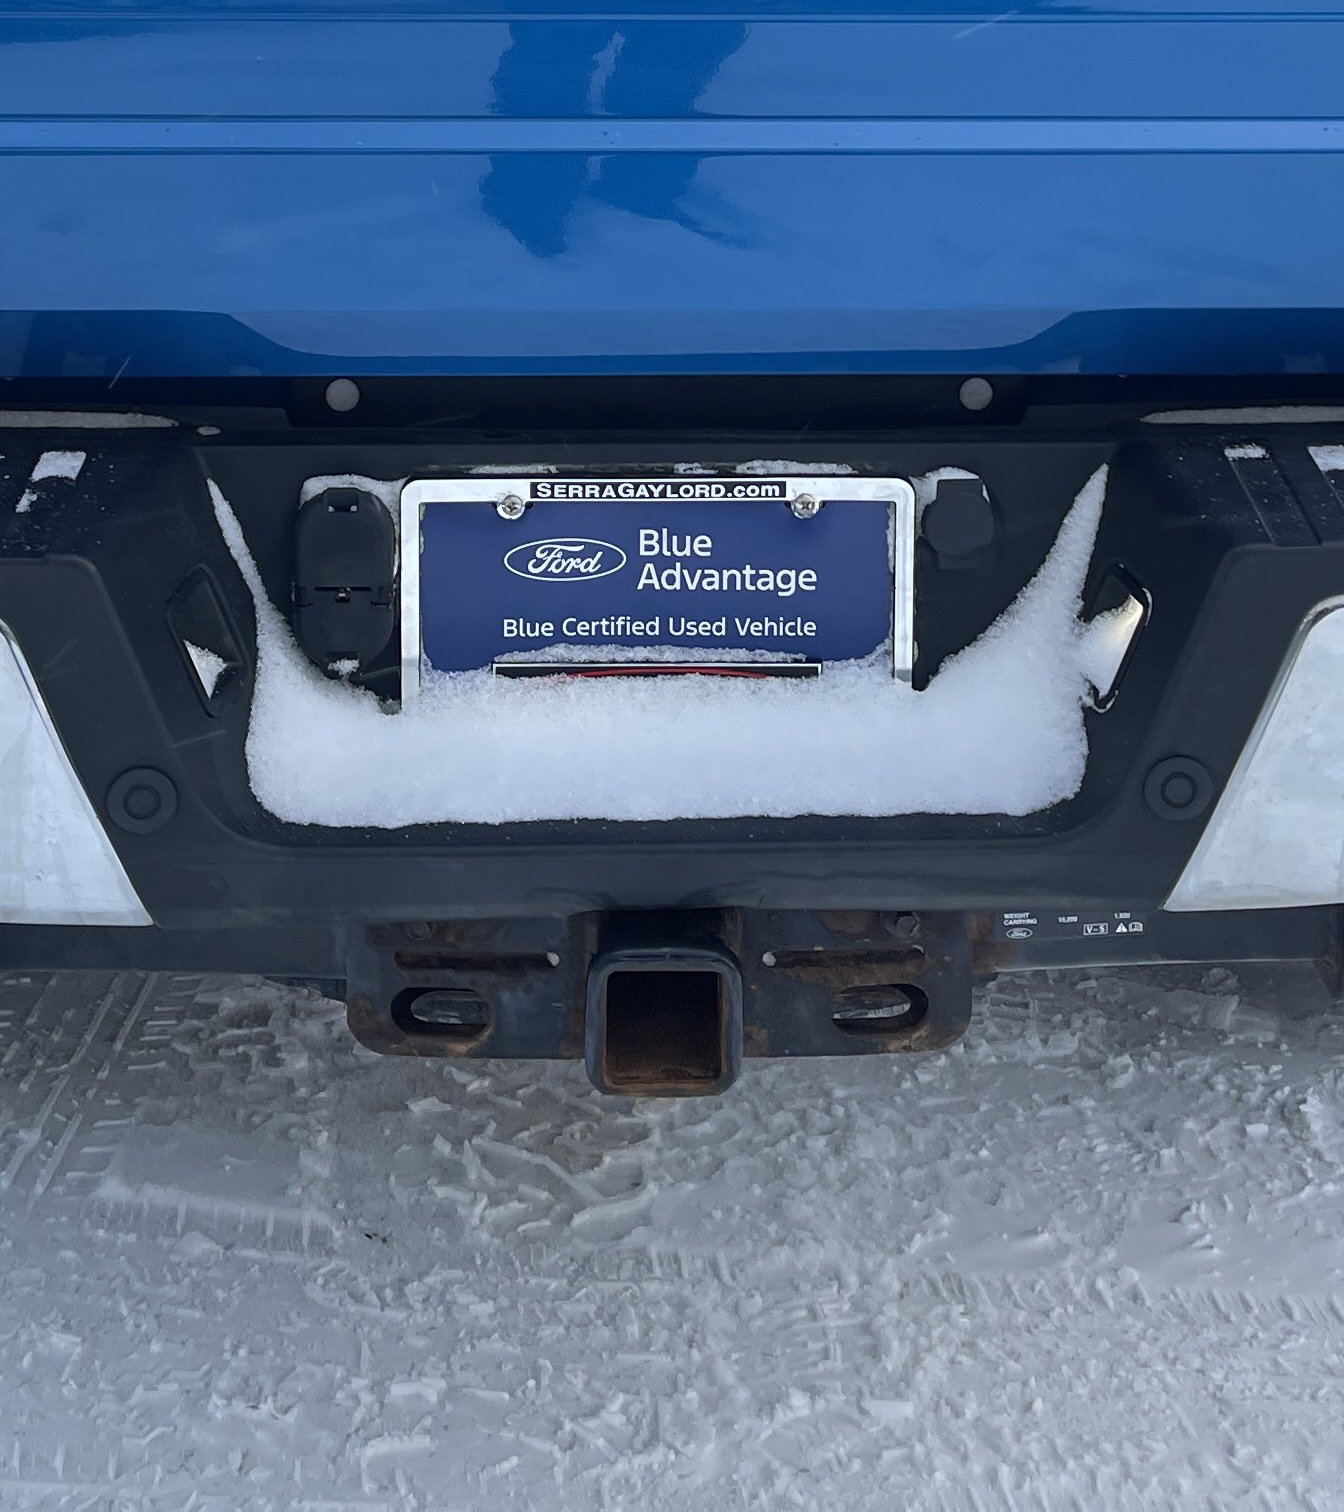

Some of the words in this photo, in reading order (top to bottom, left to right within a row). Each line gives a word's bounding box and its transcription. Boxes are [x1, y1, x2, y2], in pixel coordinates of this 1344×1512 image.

[536, 483, 780, 498] SERRAGAYLORD.com
[640, 528, 712, 556] Blue
[528, 544, 602, 574] Ford
[637, 562, 817, 596] Advantage
[504, 618, 554, 637] Blue
[563, 616, 659, 636] Certified
[670, 617, 725, 636] Used
[735, 617, 816, 636] Vehicle
